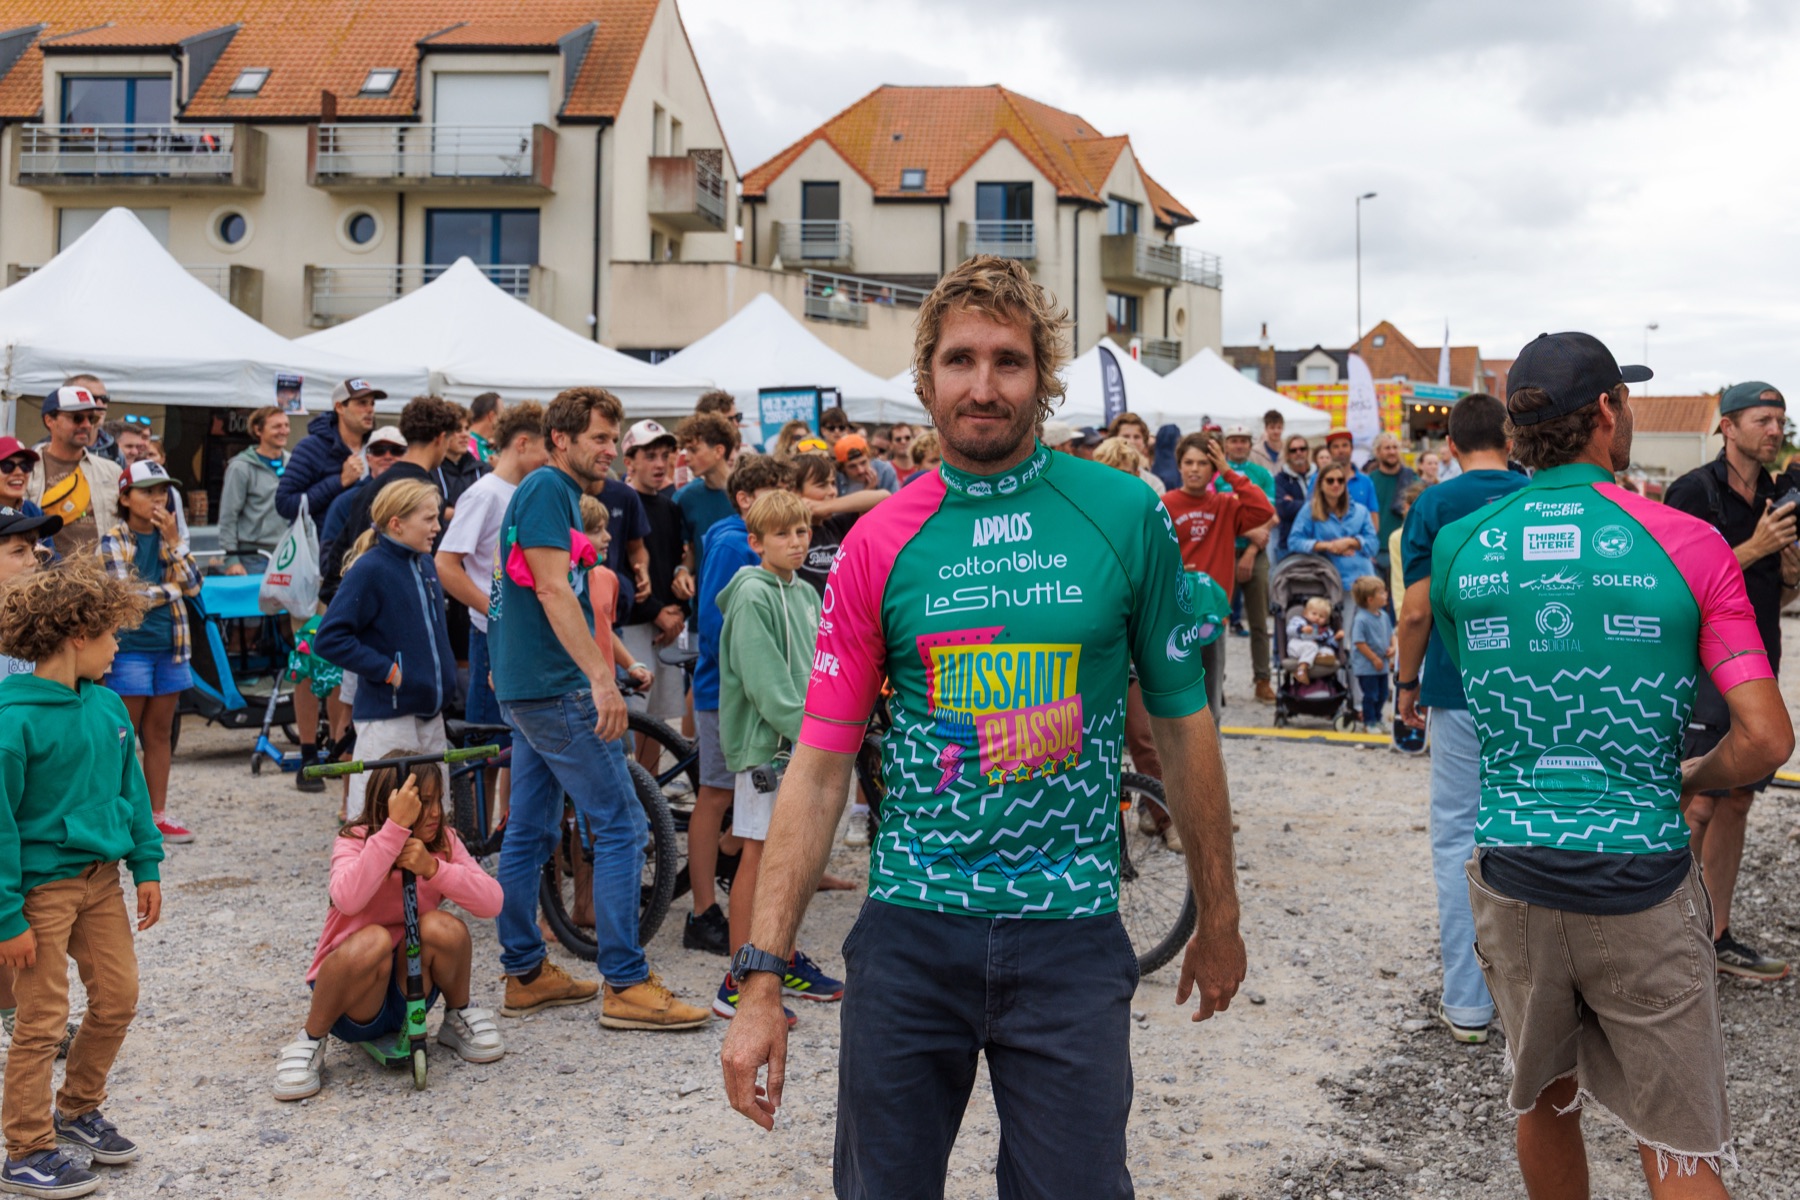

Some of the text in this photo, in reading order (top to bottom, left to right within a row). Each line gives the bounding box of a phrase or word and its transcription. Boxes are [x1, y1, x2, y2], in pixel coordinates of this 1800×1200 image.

[969, 485, 990, 493] PWA
[1536, 501, 1582, 511] Energie
[1541, 506, 1584, 518] mobile
[972, 512, 1032, 547] APPLOS
[1528, 532, 1575, 541] THIRIEZ
[1529, 541, 1575, 550] LITERIE
[938, 549, 1068, 580] cottonblue
[1459, 570, 1510, 588] Direct
[1530, 583, 1585, 591] WISSANT
[1592, 573, 1657, 588] SOLERO
[1460, 584, 1510, 600] OCEAN
[1465, 616, 1510, 639] LSS
[1603, 614, 1661, 638] LSS
[938, 651, 1073, 710] WISSANT
[985, 702, 1079, 764] CLASSIC
